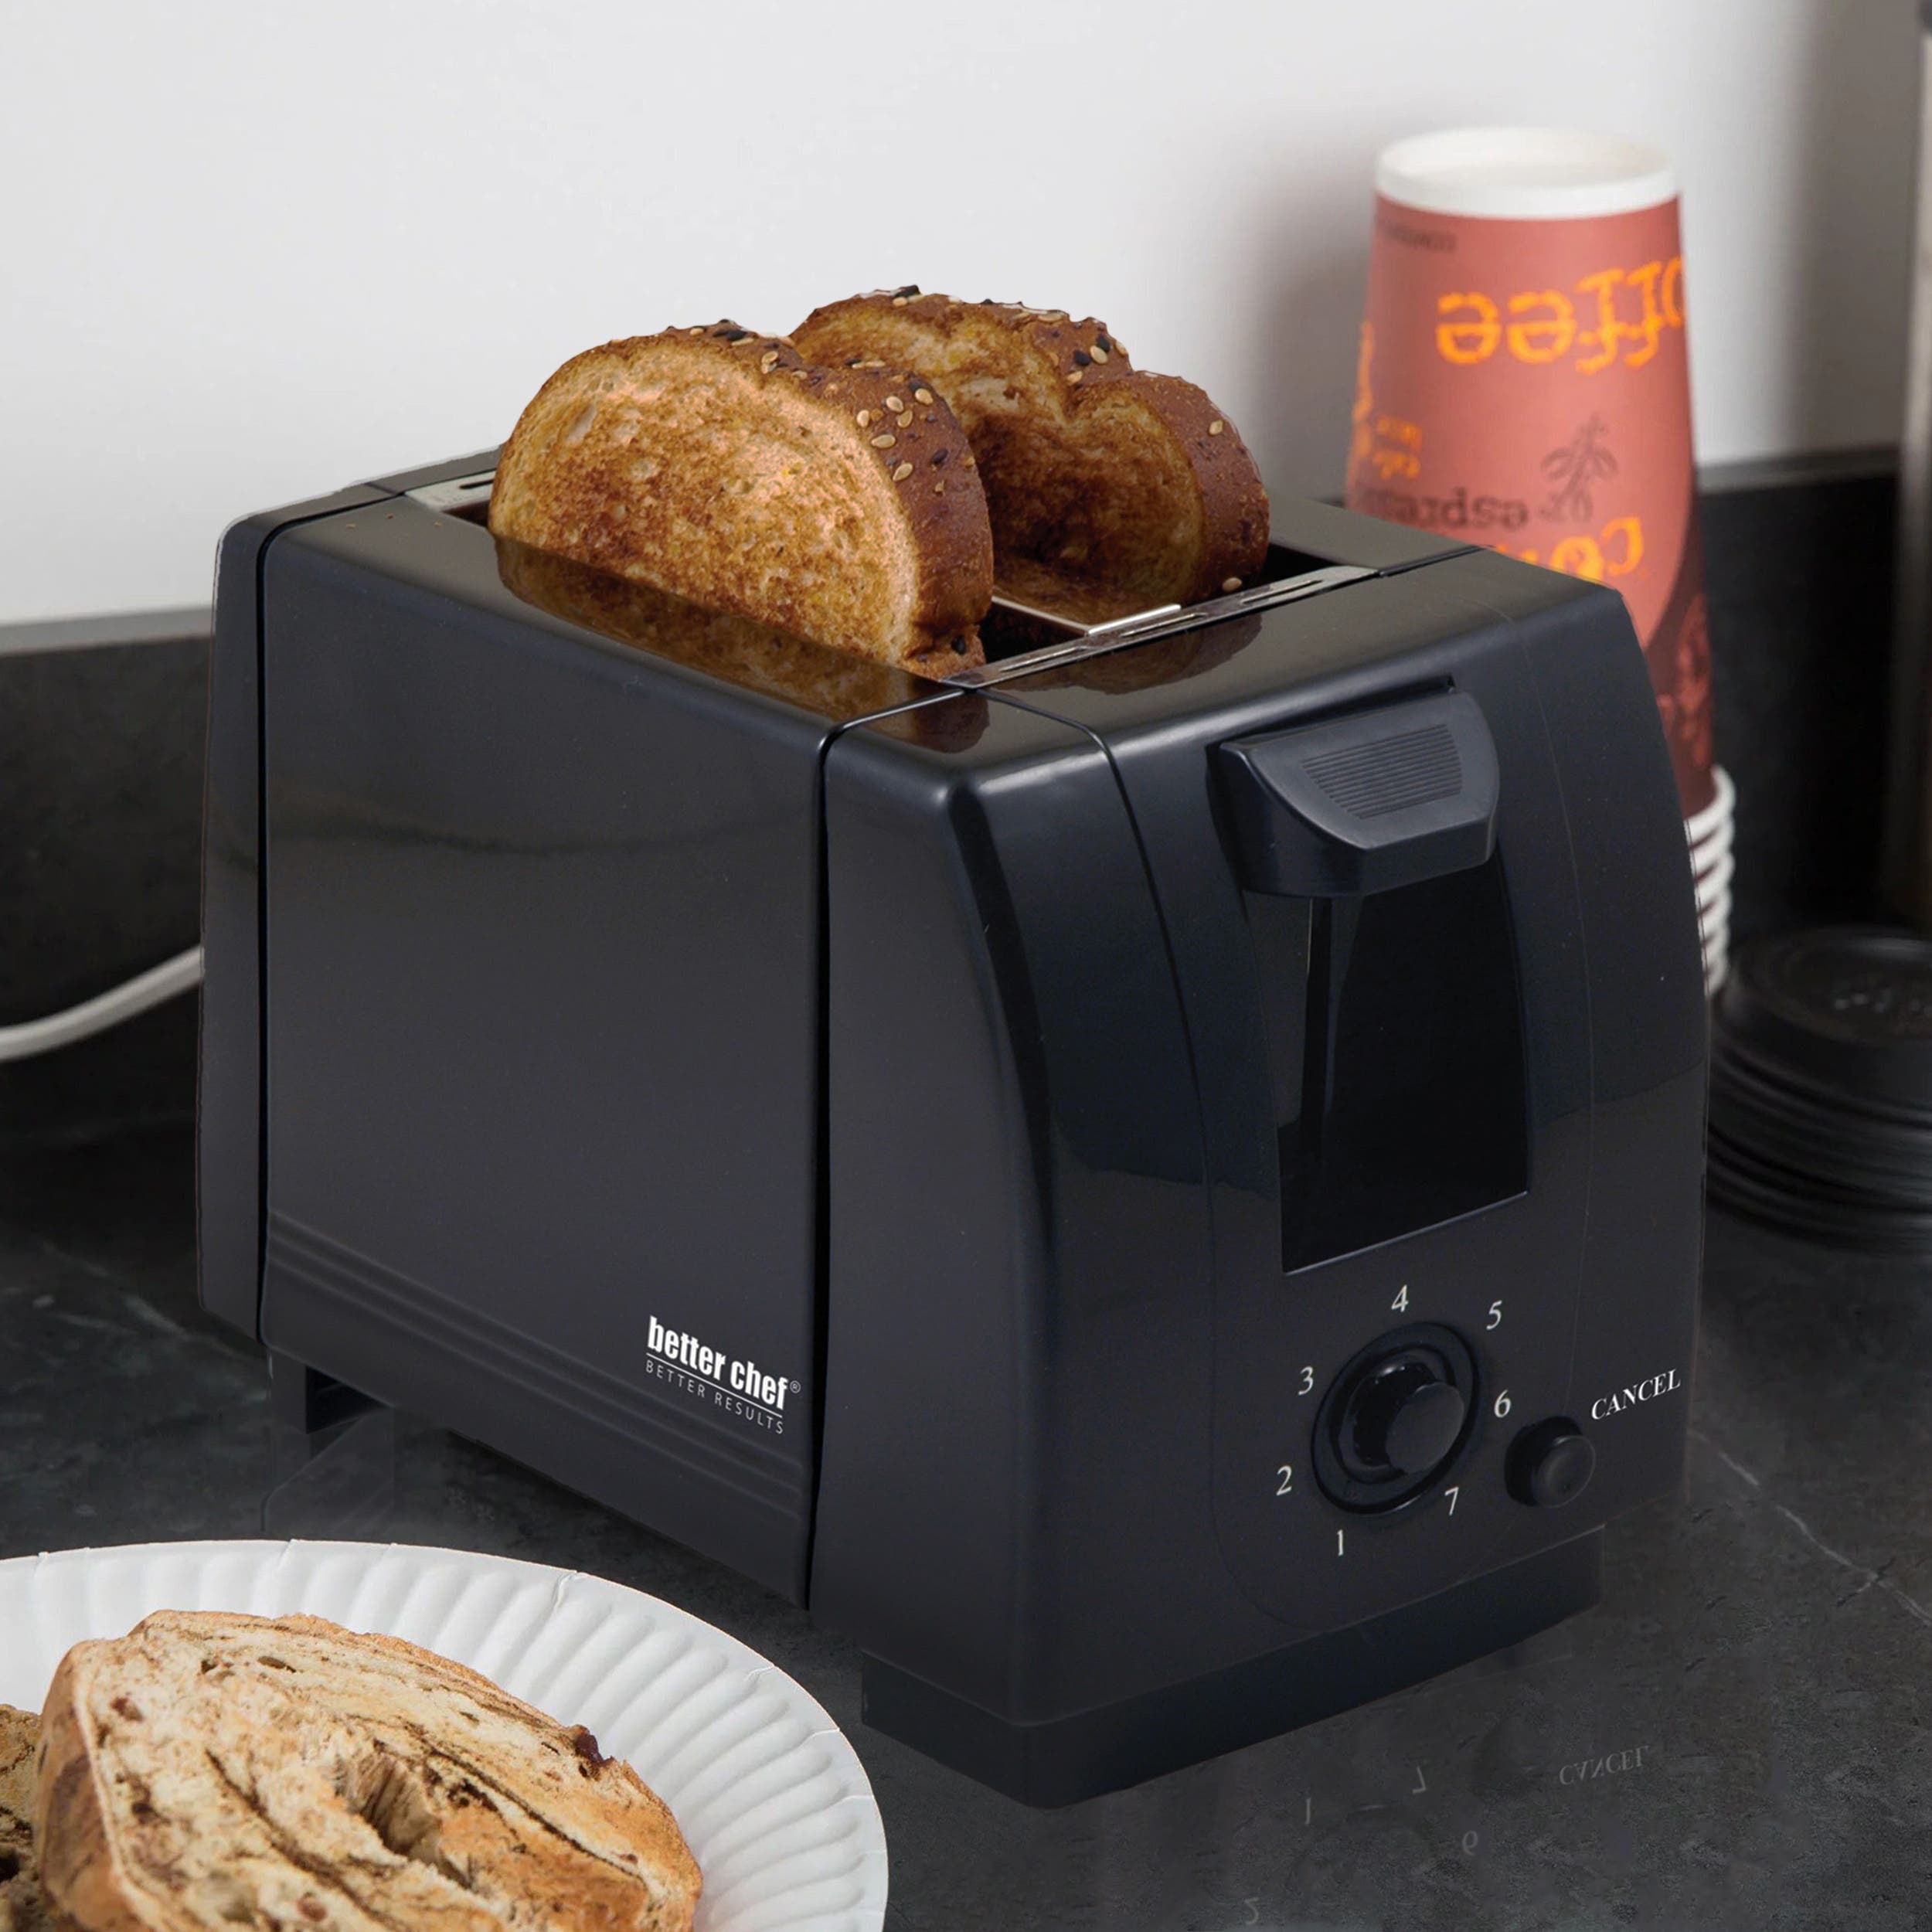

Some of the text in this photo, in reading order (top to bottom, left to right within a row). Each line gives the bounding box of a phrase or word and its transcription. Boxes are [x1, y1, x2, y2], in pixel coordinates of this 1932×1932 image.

[1390, 1284, 1409, 1313] 4
[1485, 1299, 1503, 1331] 5
[647, 1315, 726, 1382] better
[1297, 1365, 1315, 1396] 3
[1590, 1368, 1682, 1421] CANCEL
[645, 1359, 784, 1435] BETTER RESULTS
[1493, 1389, 1512, 1419] 6
[1275, 1464, 1293, 1497] 2
[1444, 1485, 1460, 1516] 7
[1336, 1529, 1345, 1557] 1
